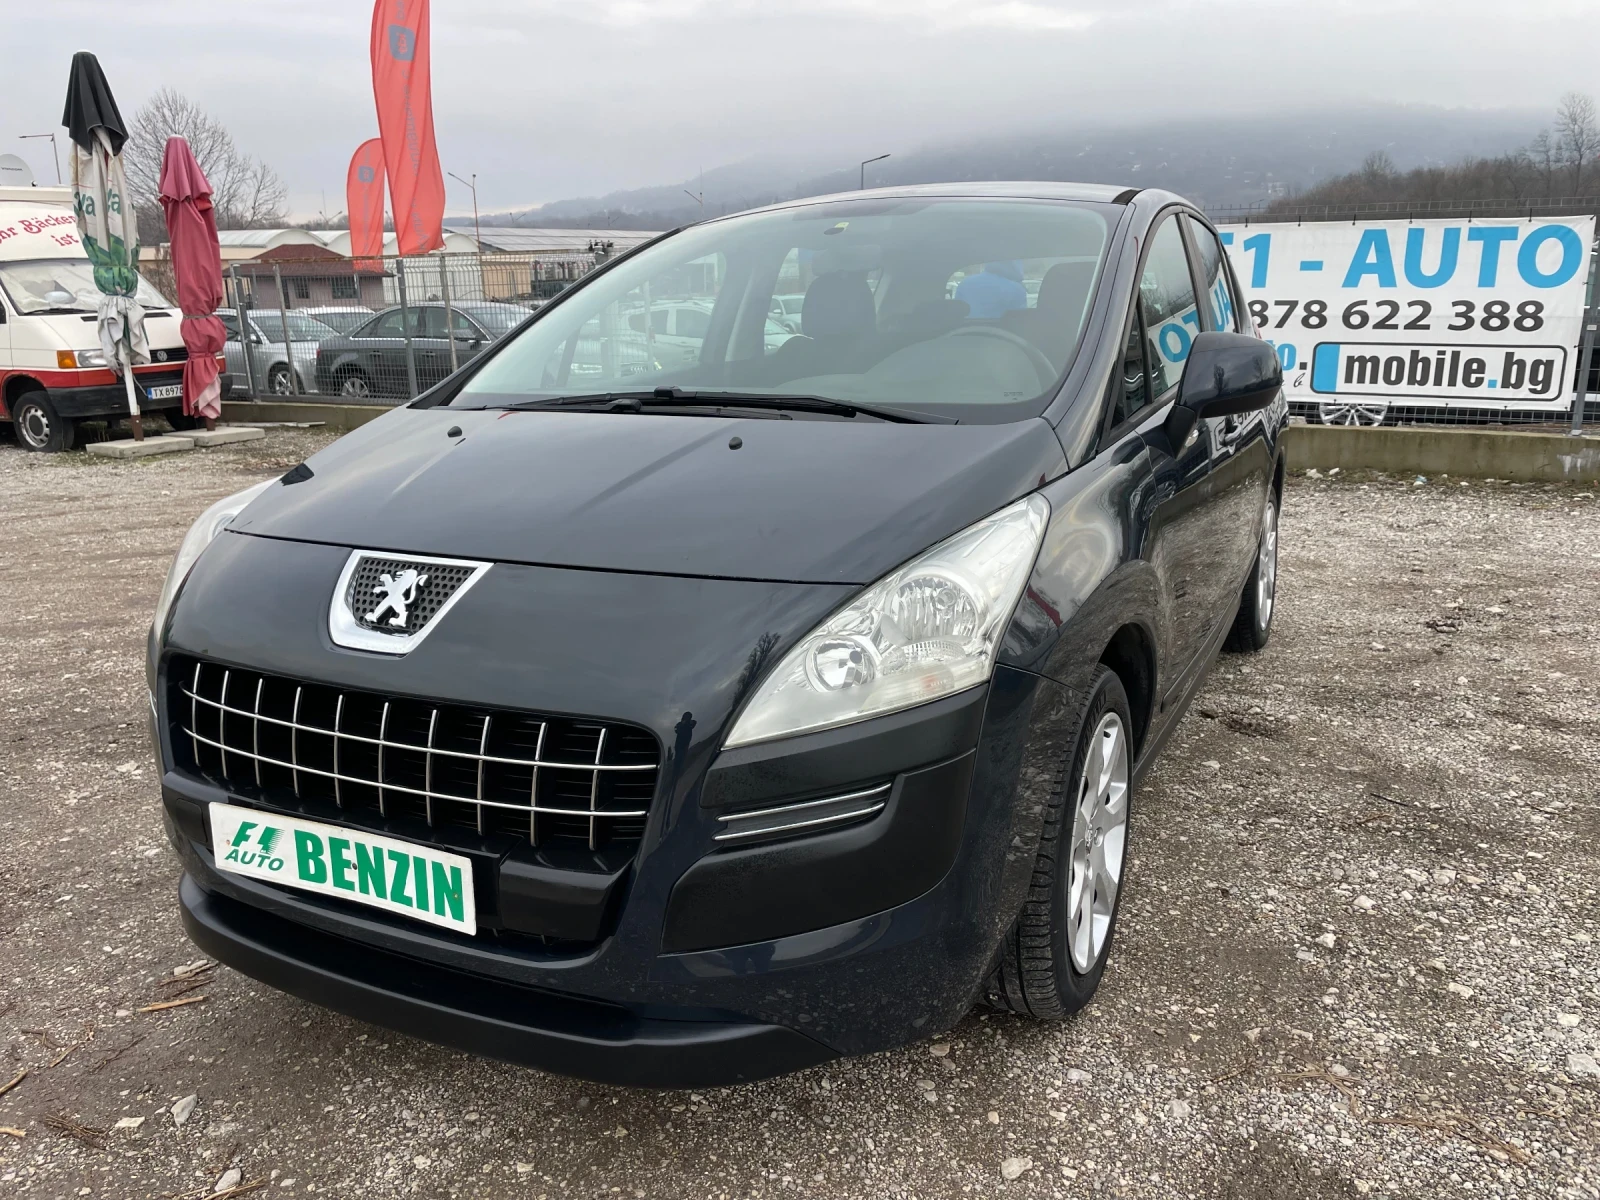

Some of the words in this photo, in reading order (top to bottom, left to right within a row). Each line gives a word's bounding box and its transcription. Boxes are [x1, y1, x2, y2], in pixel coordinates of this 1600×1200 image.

[0, 227, 18, 244] hr
[51, 233, 79, 246] ist
[1341, 224, 1583, 289] AUTO
[1341, 299, 1432, 331] 622
[1447, 299, 1545, 332] 388
[1344, 349, 1555, 394] mobile.bg
[224, 848, 285, 872] AUTO
[293, 829, 465, 923] BENZIN
